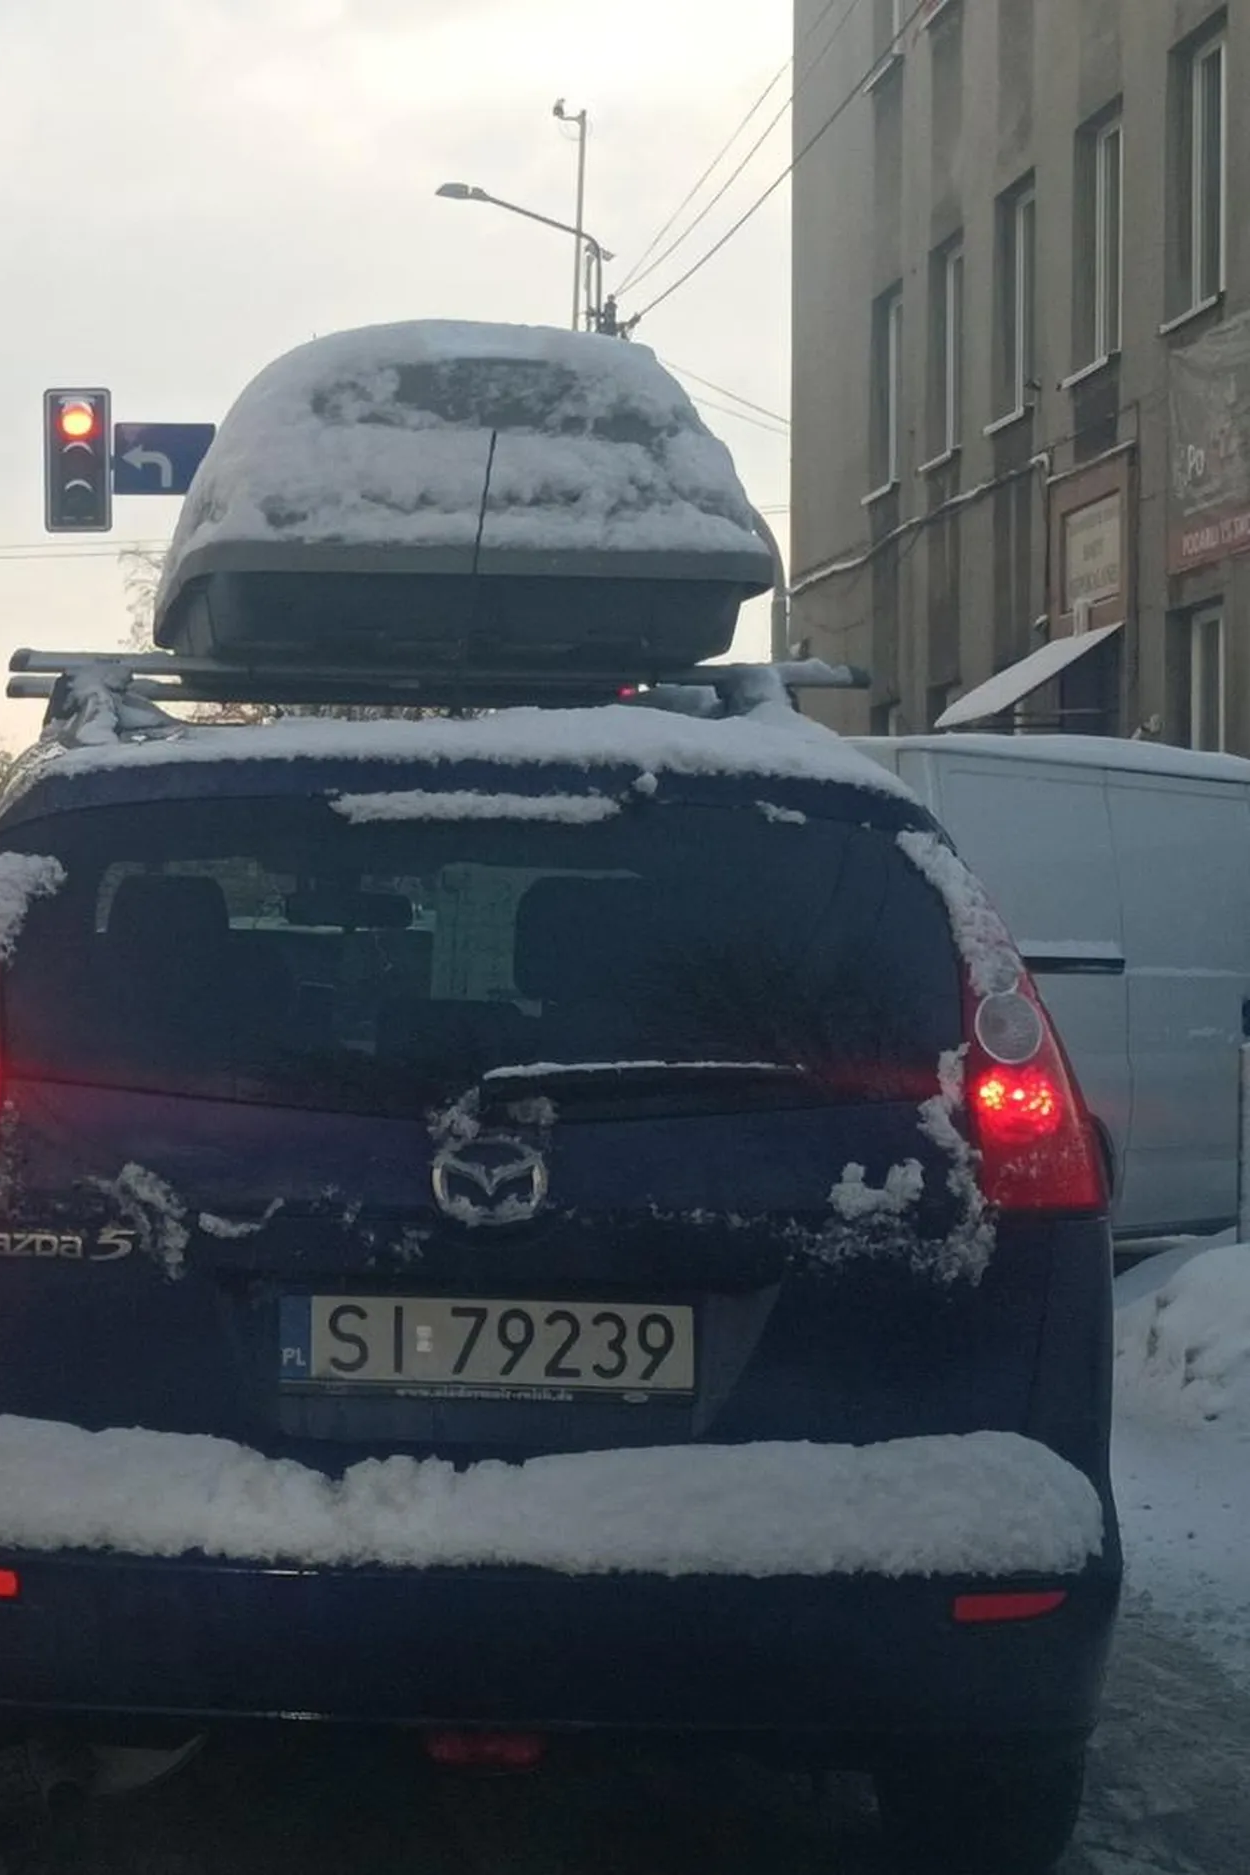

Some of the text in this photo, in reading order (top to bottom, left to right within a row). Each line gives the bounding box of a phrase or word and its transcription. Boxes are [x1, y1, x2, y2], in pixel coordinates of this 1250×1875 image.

[90, 1229, 137, 1261] 5
[281, 1348, 307, 1367] PL
[327, 1304, 676, 1381] SI 79239
